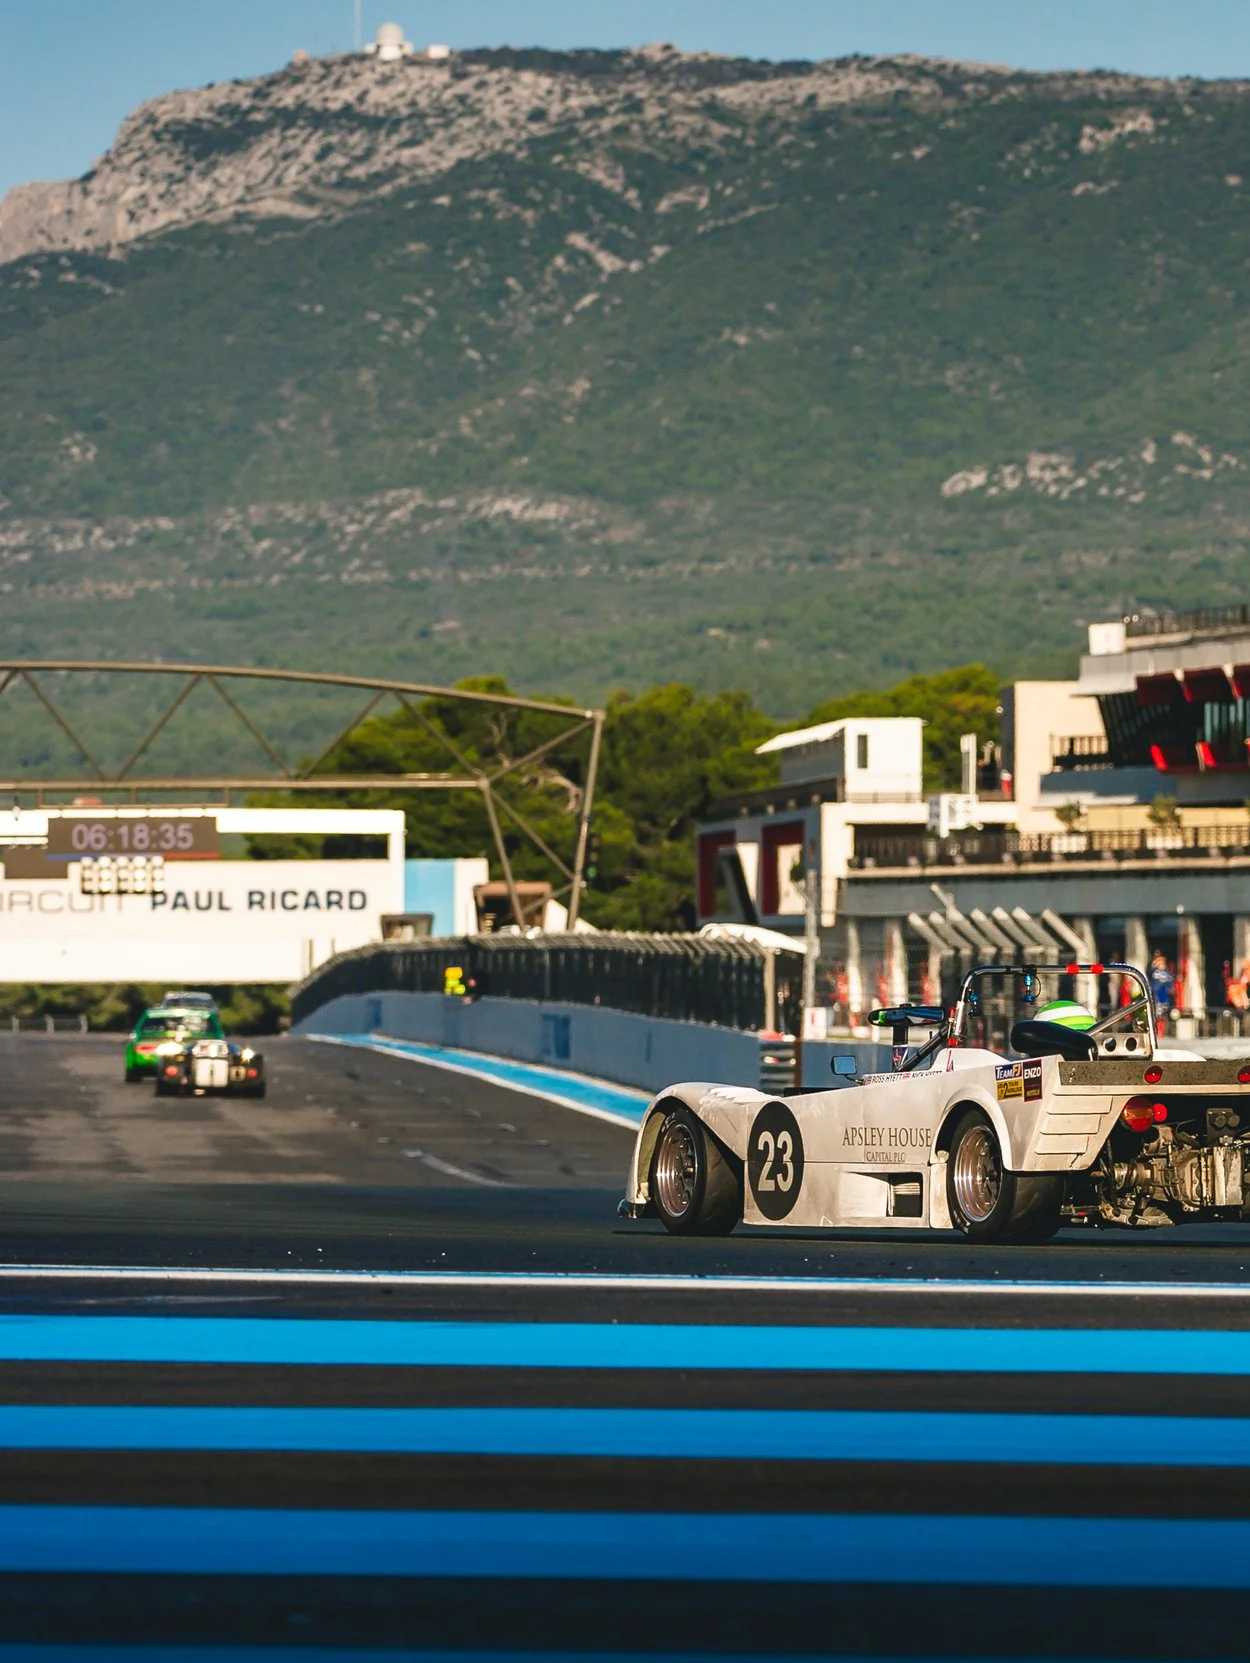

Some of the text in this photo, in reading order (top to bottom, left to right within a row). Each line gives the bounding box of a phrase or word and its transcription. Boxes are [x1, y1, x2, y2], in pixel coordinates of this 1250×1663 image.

[71, 822, 194, 850] 06:18:35
[151, 890, 231, 911] PAUL
[247, 889, 368, 911] RICARD
[1024, 1066, 1042, 1080] ENZO
[842, 1126, 932, 1148] APSLEY HOUSE
[757, 1130, 794, 1192] 23
[866, 1151, 906, 1163] CAPITAL PLC
